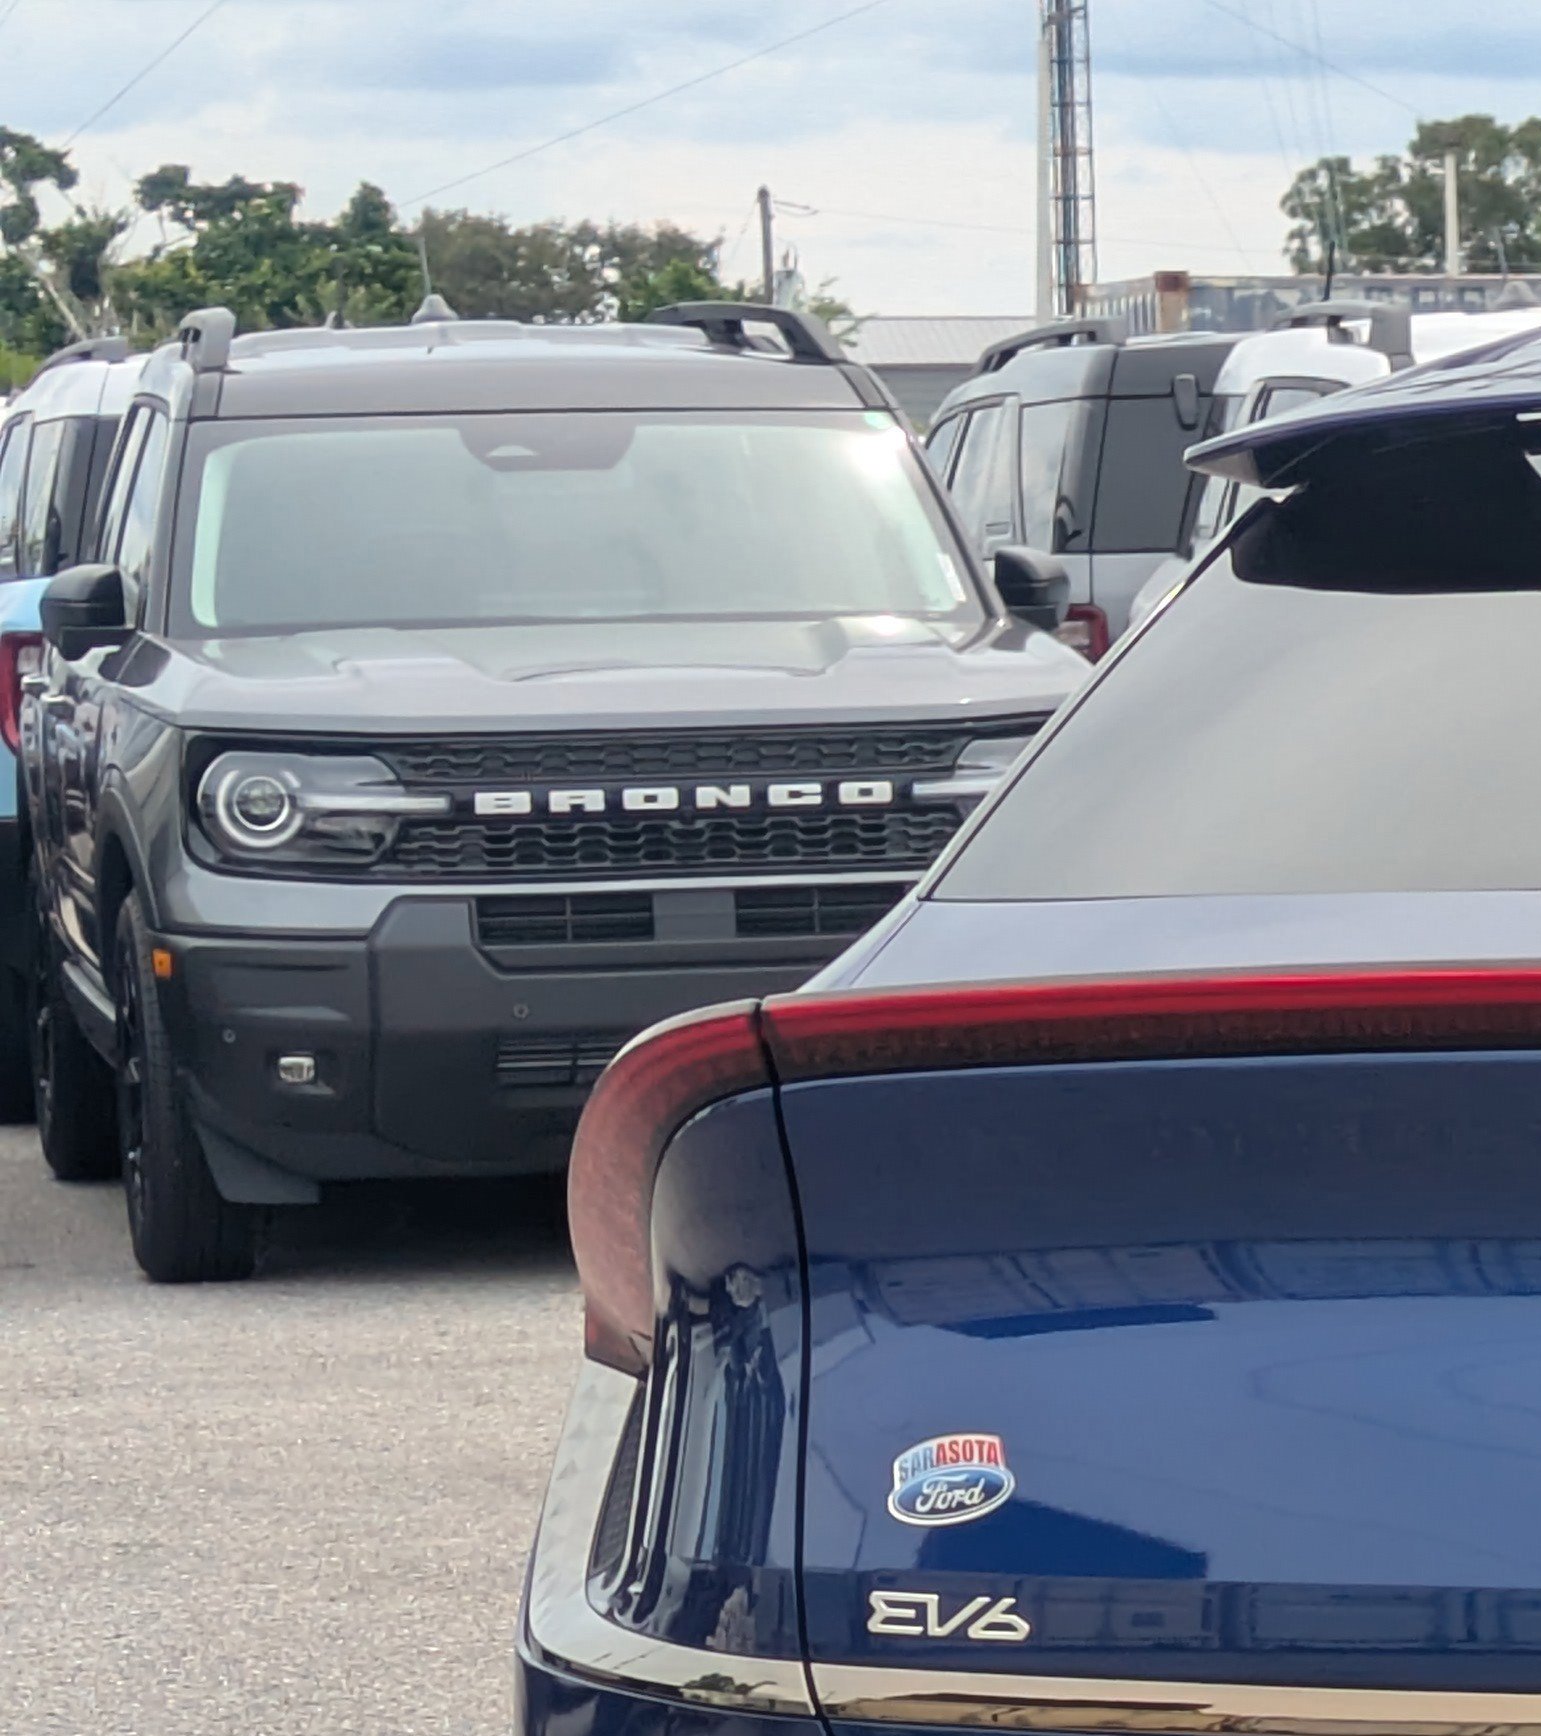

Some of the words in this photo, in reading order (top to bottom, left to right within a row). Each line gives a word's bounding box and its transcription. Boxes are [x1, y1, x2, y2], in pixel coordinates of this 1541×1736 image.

[474, 781, 892, 815] BRONCO
[898, 1439, 998, 1480] SARASOTA
[915, 1474, 984, 1512] Ford
[867, 1590, 1030, 1640] EV6
